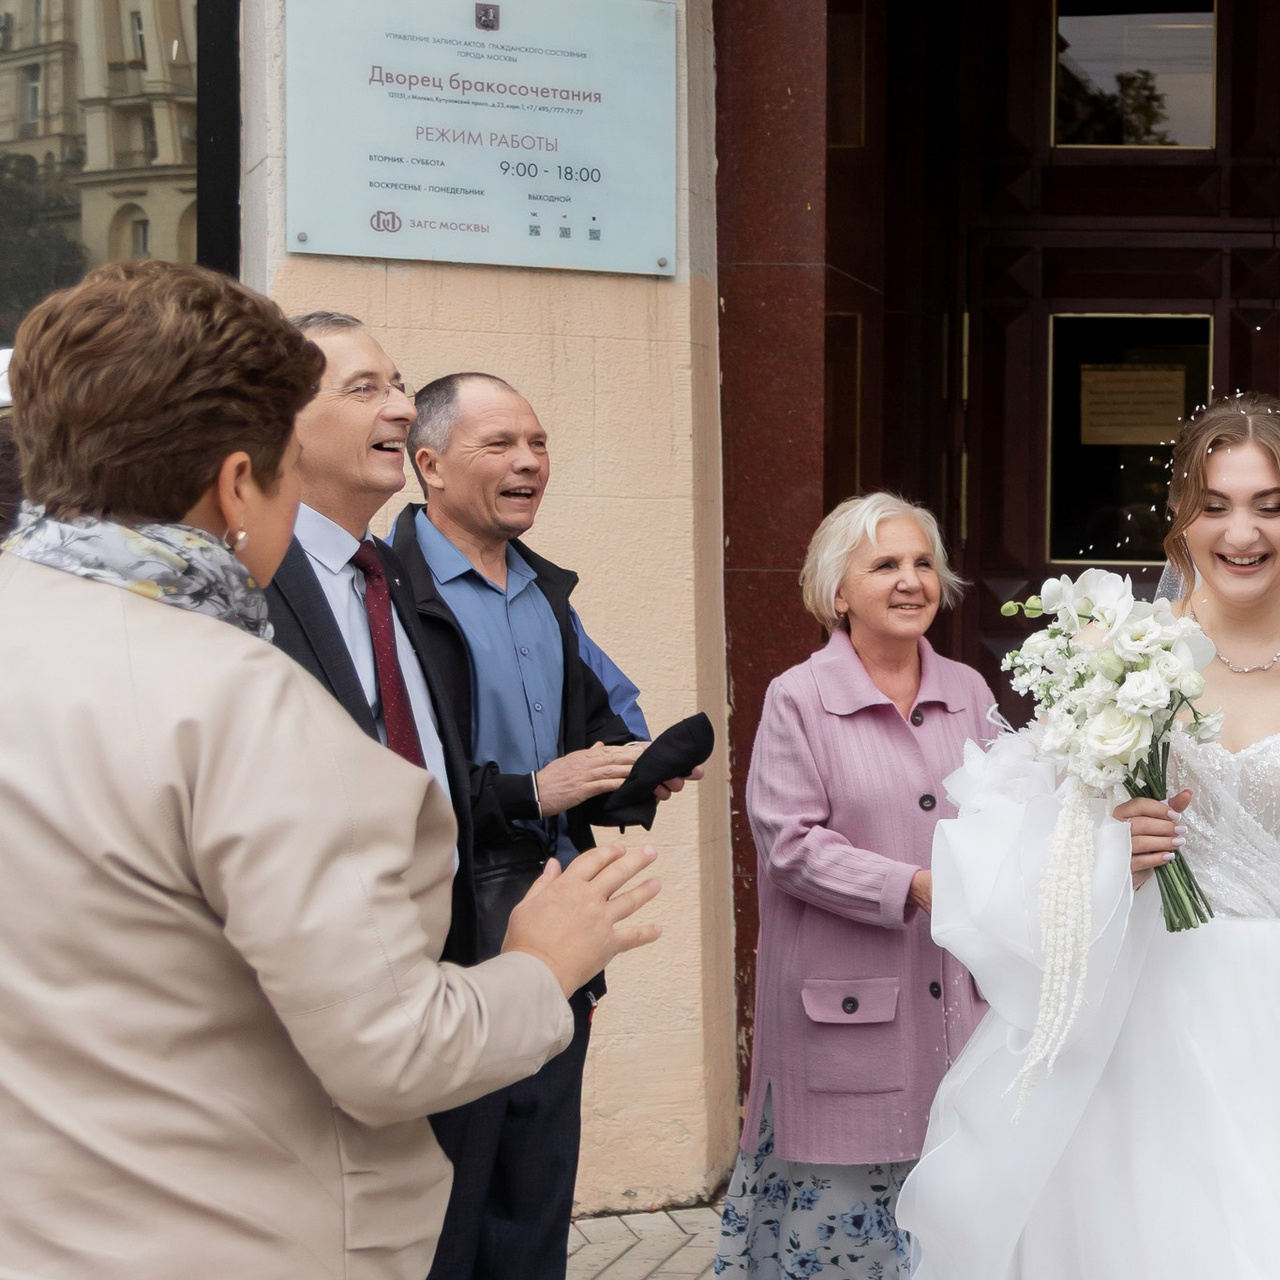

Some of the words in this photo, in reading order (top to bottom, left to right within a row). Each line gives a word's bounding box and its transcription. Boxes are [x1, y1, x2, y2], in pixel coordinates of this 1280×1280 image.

[385, 32, 430, 44] УПРАВЛЕНИЕ
[432, 36, 462, 47] ЗАПИСИ
[463, 40, 486, 49] АКТОВ
[488, 43, 543, 55] ГРАЖДАНСКОГО
[544, 48, 588, 59] СОСТОЯНИЯ
[457, 50, 485, 60] ГОРОДА
[486, 54, 518, 63] МОСКВЫ
[369, 65, 444, 90] Дворец
[449, 72, 602, 103] бракосочетания
[415, 126, 483, 146] РЕЖИМ
[489, 132, 559, 152] РАБОТЫ
[368, 154, 405, 164] ВТОРНИК
[410, 157, 446, 167] СУББОТА
[499, 160, 538, 178] 9:00
[556, 165, 601, 183] 18:00
[368, 181, 422, 192] ВОСКРЕСЕНЬЕ
[428, 185, 486, 196] ПОНЕДЕЛЬНИК
[528, 192, 572, 203] ВЫХОДНОЙ
[409, 219, 437, 230] ЗАГС
[439, 222, 490, 233] МОСКВЫ
